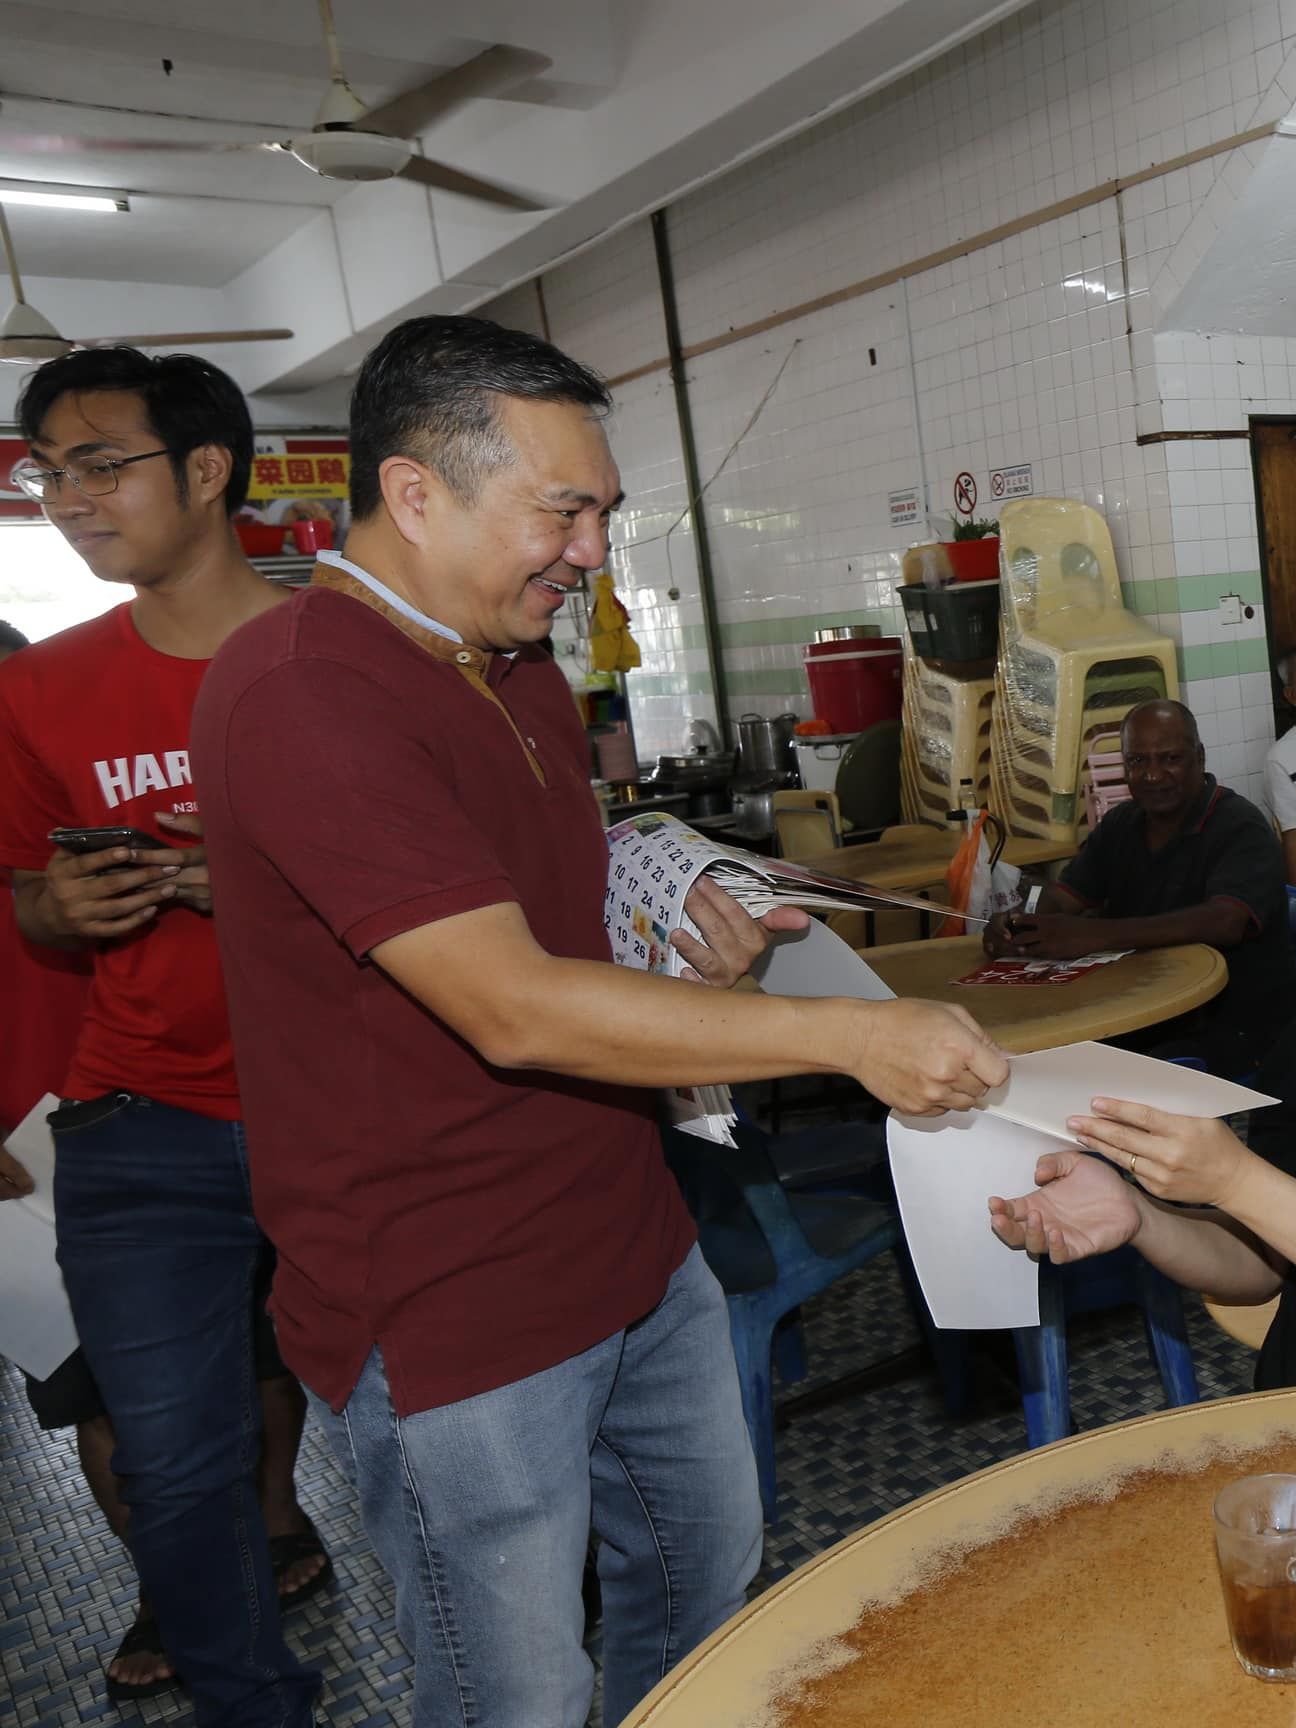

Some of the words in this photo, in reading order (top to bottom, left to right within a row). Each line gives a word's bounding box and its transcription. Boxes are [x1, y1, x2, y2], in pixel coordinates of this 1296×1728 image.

[622, 835, 634, 845] 2
[631, 845, 642, 856] 9
[640, 855, 653, 870] 16
[651, 866, 665, 883] 23
[664, 880, 677, 898] 30
[660, 839, 673, 851] 15
[668, 848, 684, 862] 22
[678, 858, 694, 874] 29
[614, 863, 626, 880] 10
[627, 876, 639, 893] 17
[641, 890, 653, 910] 24
[658, 905, 670, 925] 31
[621, 901, 631, 919] 18
[617, 926, 628, 943] 19
[634, 940, 646, 959] 26
